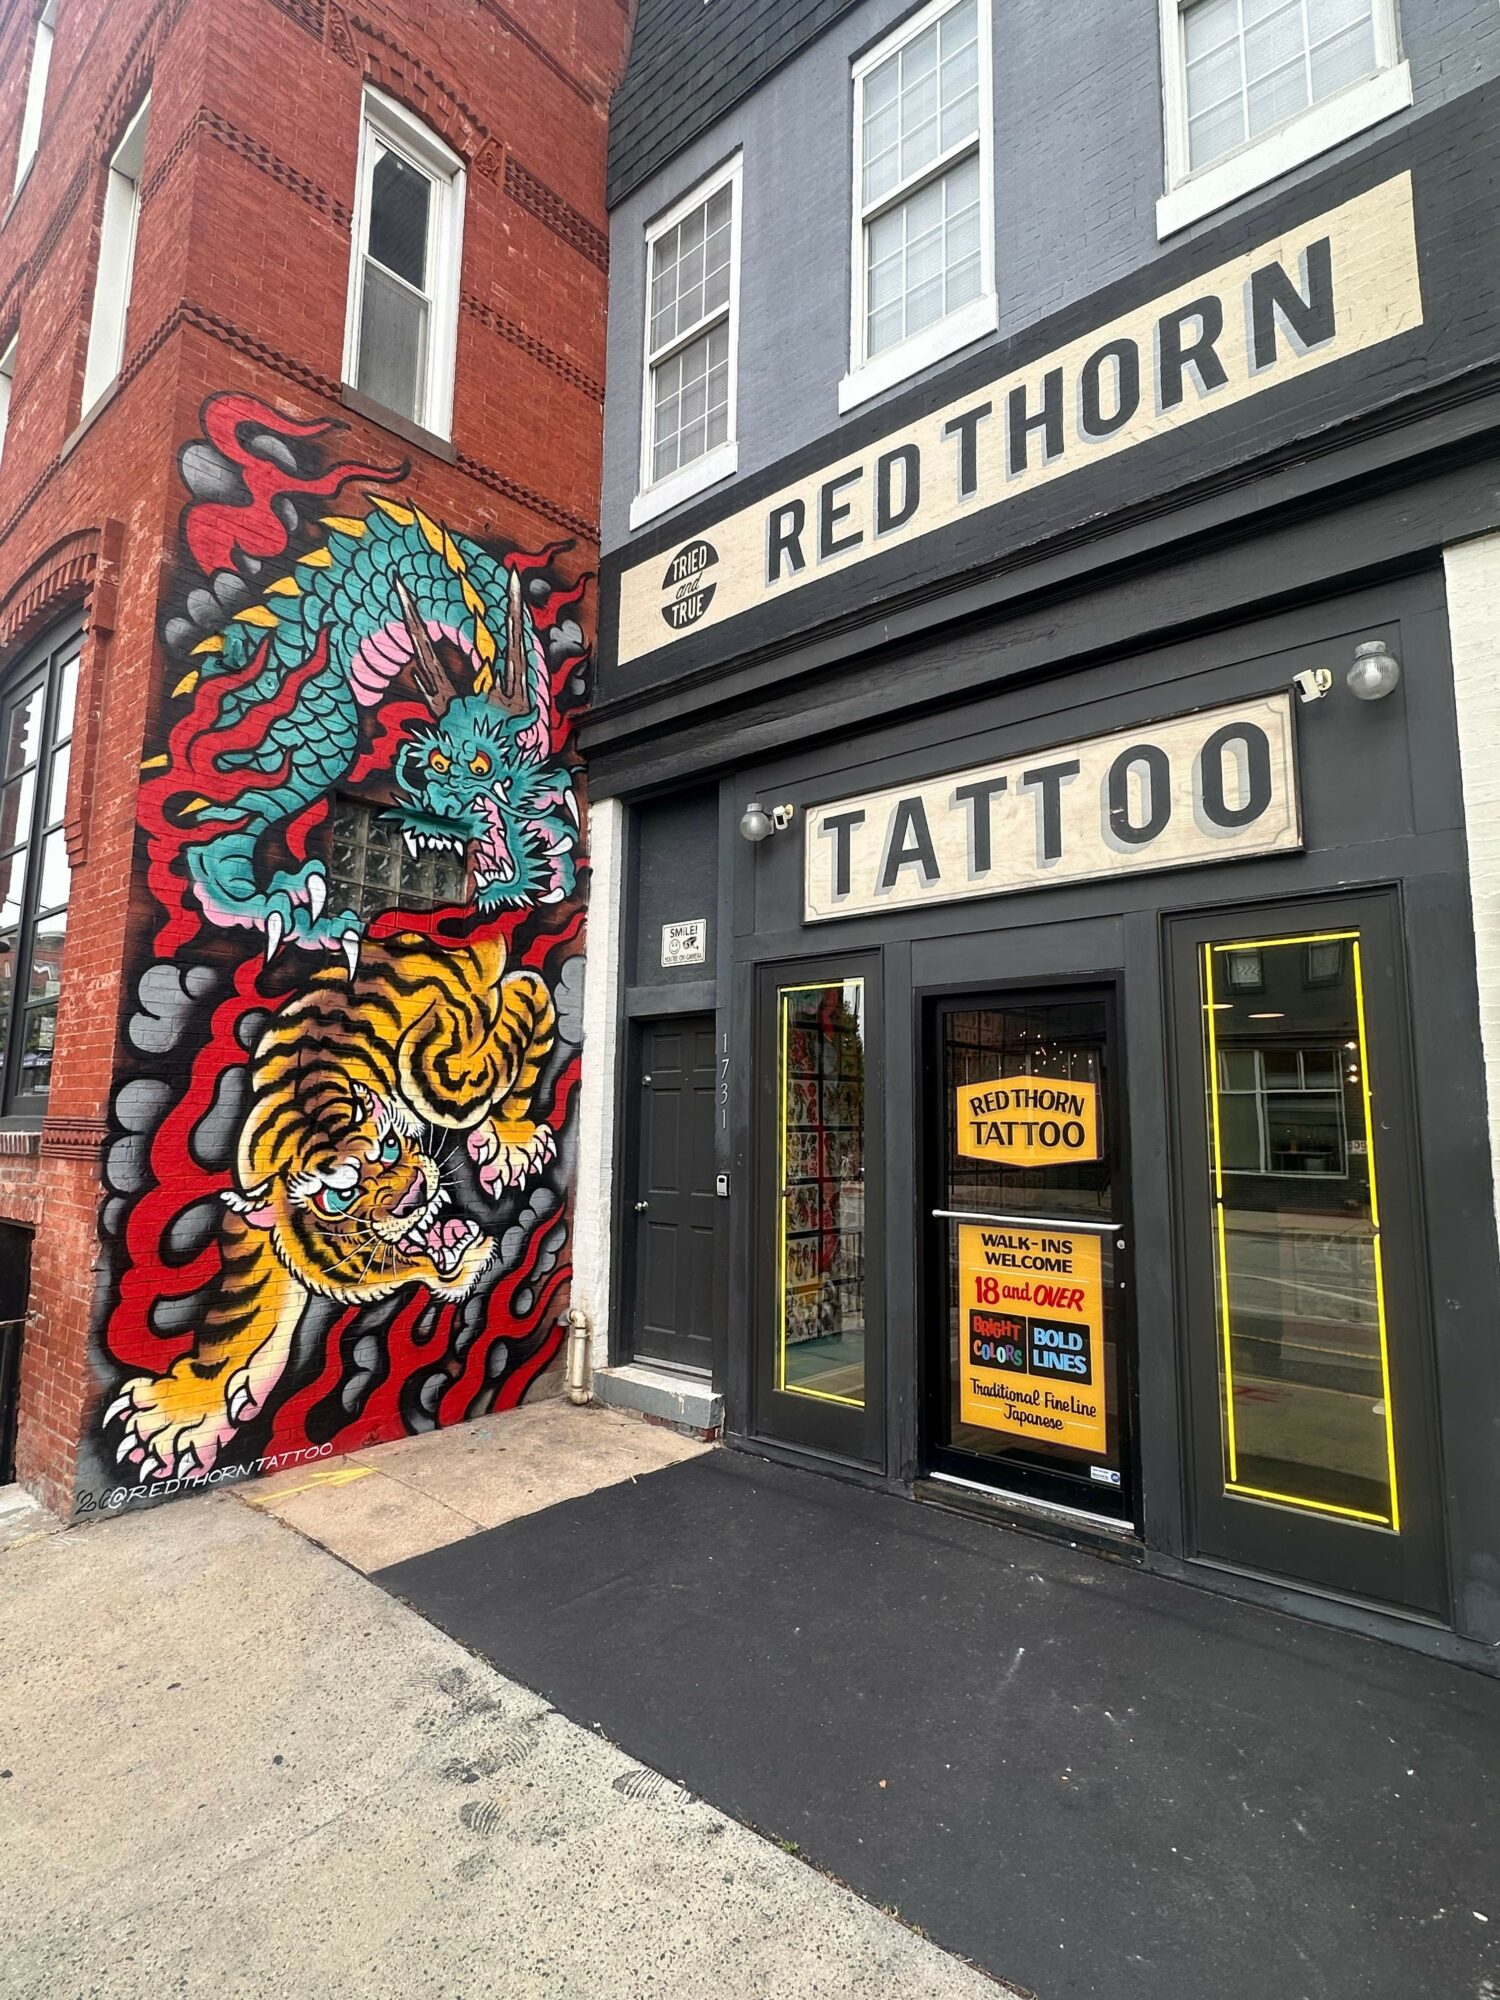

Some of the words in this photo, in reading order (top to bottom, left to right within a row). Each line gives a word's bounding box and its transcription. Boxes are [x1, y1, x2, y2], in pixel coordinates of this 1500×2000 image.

[672, 545, 708, 582] TRIED
[675, 571, 704, 600] and
[671, 593, 705, 628] TRUE
[819, 721, 1272, 902] TATTOO
[720, 1032, 730, 1129] 1731
[969, 1120, 1086, 1149] TATTOO
[981, 1232, 1073, 1255] WALK-INS
[984, 1251, 1073, 1274] WELCOME
[974, 1275, 1001, 1305] 18
[1001, 1281, 1033, 1302] and
[1033, 1284, 1085, 1312] OVER
[973, 1315, 1022, 1341] BRIGHT
[1033, 1327, 1083, 1351] BOLD
[973, 1339, 1023, 1367] COLORS
[1032, 1349, 1087, 1375] LINES
[969, 1377, 1041, 1407] Traditional
[1003, 1402, 1064, 1431] Japanese
